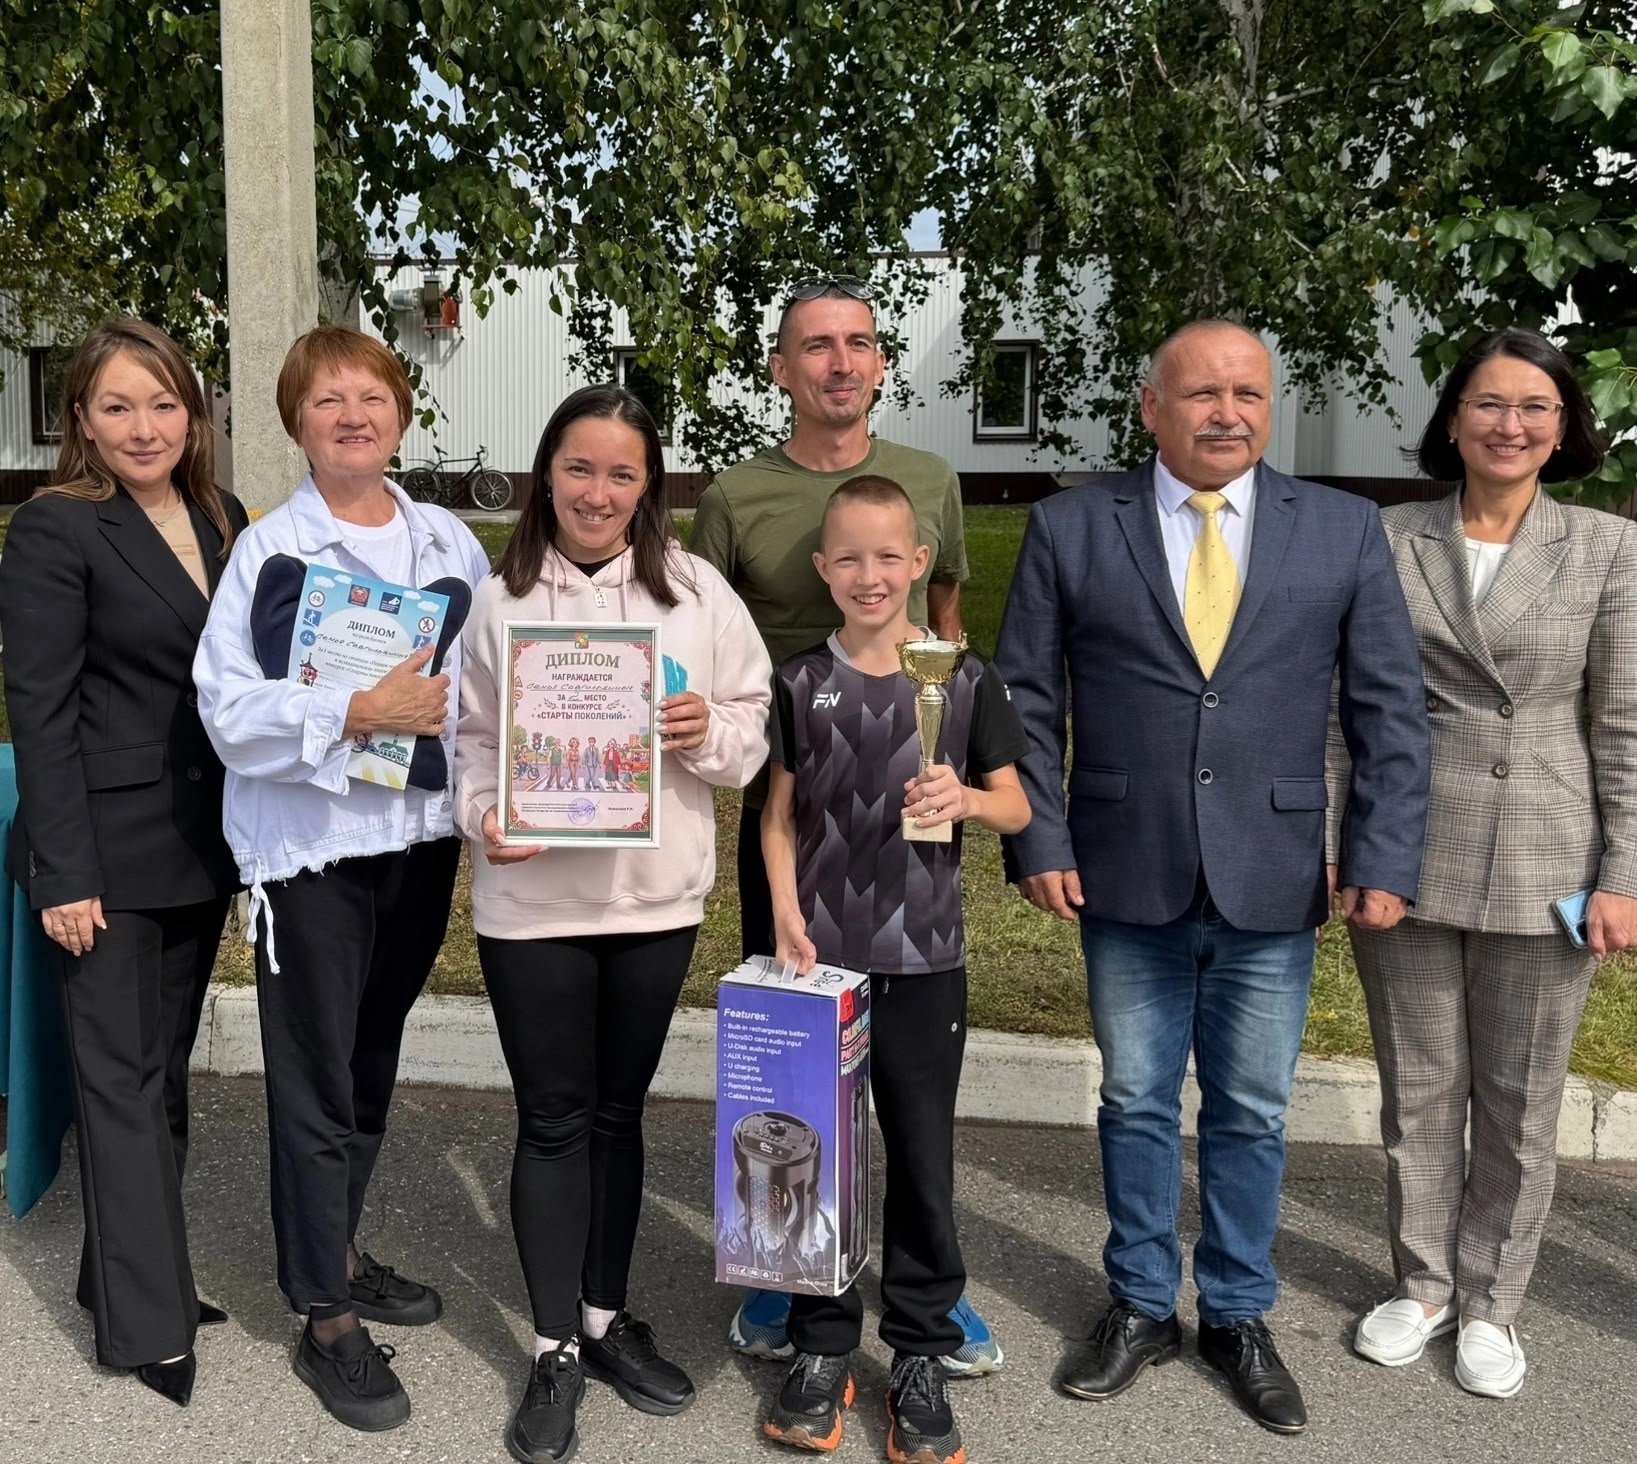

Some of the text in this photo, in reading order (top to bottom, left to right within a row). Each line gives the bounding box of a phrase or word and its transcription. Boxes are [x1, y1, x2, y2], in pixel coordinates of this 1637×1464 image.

[346, 620, 396, 639] ДИПЛОМ
[545, 652, 621, 670] ДИПЛОМ
[551, 673, 613, 682] НАГРАЖДАЕТСЯ
[812, 691, 842, 709] FN
[567, 703, 602, 711] КОНКУРСЕ
[536, 711, 627, 720] «СТАРТЫ ПОКОЛЕНИЙ»
[723, 1007, 770, 1021] Features:
[727, 1023, 810, 1039] Built-in rechargeable battery
[754, 1036, 767, 1044] card
[768, 1038, 785, 1046] audio
[786, 1040, 802, 1048] input
[727, 1042, 782, 1056] U-Disk audio input
[727, 1052, 758, 1062] AUX input
[734, 1063, 760, 1073] charging
[727, 1071, 763, 1082] Microphone
[727, 1081, 773, 1094] Remote control
[727, 1091, 775, 1104] Cables included
